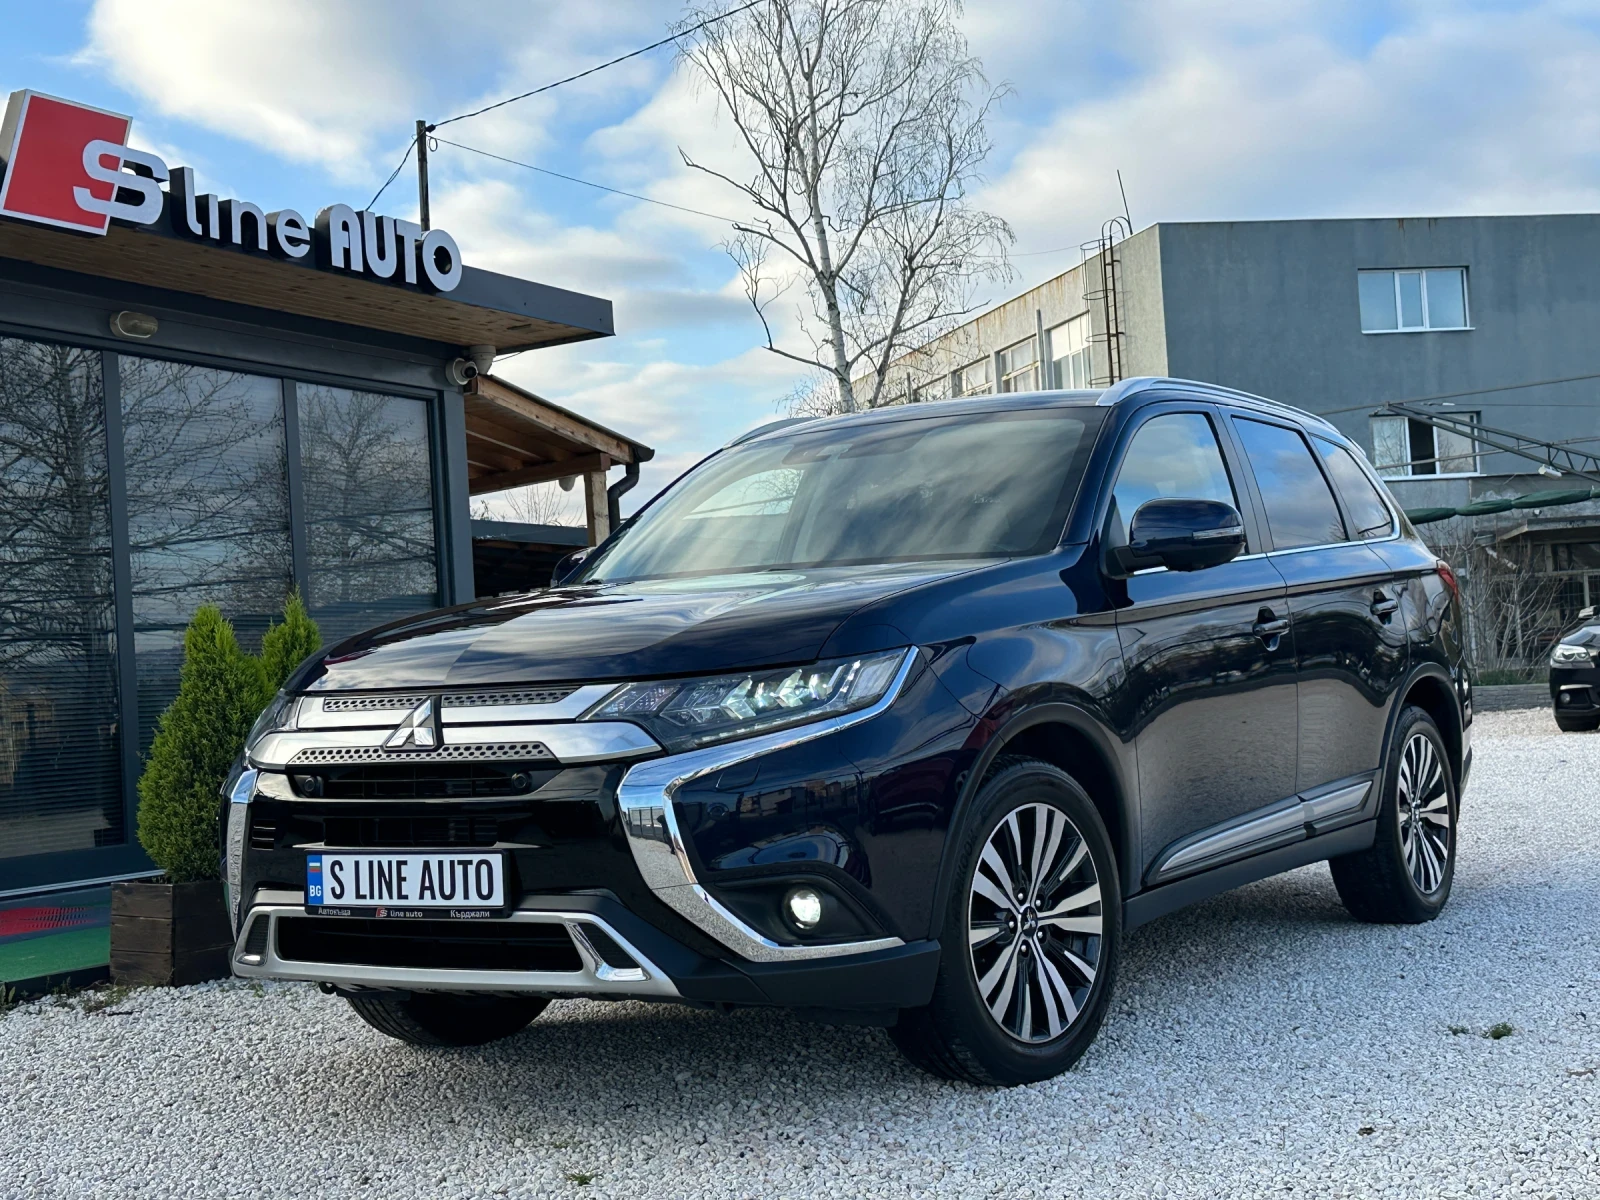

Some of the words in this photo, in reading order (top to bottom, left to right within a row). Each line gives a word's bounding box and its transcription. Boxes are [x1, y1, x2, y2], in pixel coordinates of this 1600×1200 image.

[73, 139, 169, 225] S
[182, 166, 311, 258] line
[328, 203, 463, 292] AUTO
[309, 885, 322, 897] BG
[330, 859, 345, 900] S
[354, 859, 409, 900] LINE
[418, 858, 494, 901] AUTO
[450, 909, 490, 919] Кърджали
